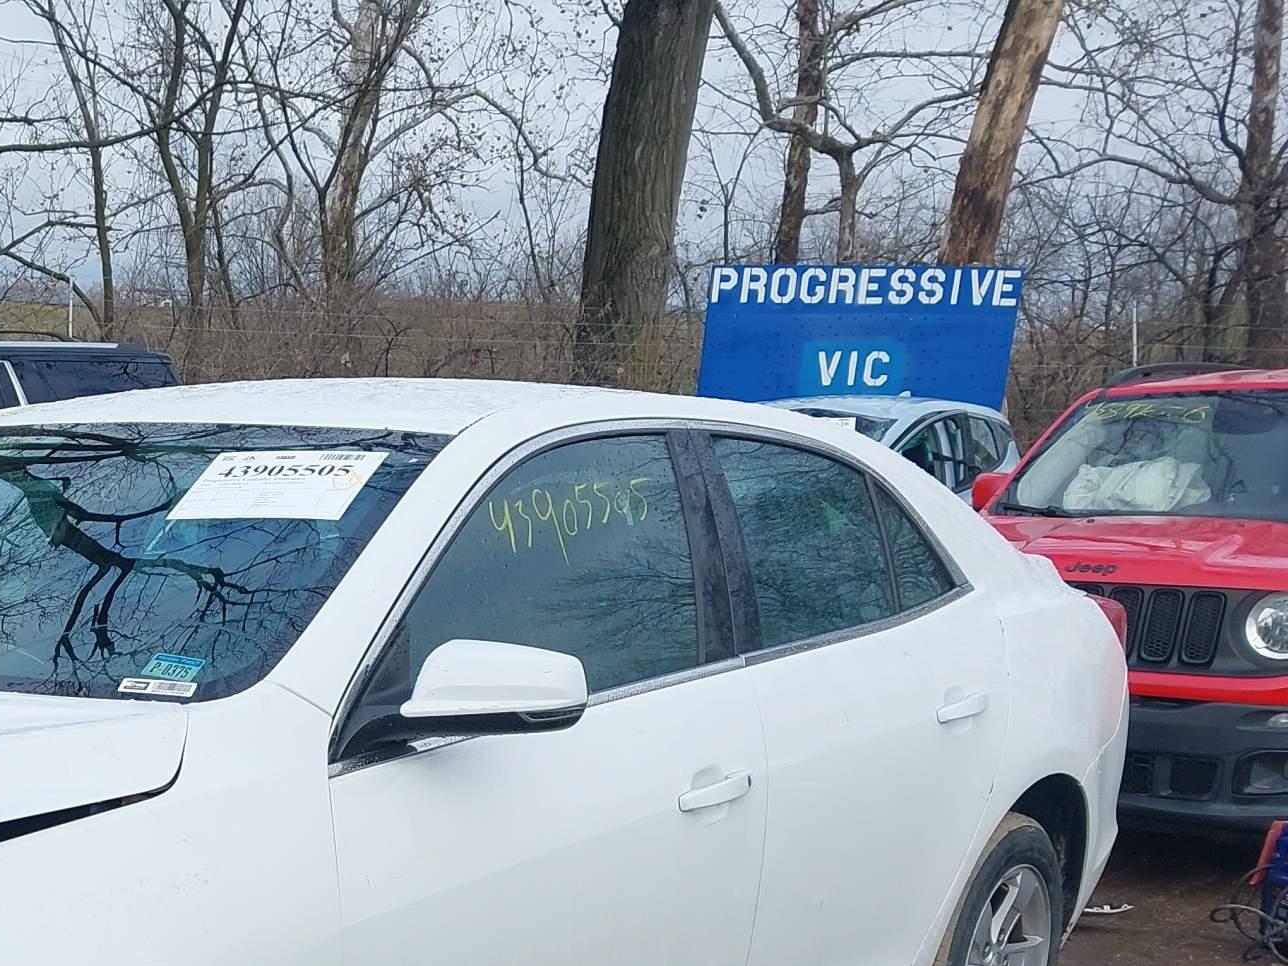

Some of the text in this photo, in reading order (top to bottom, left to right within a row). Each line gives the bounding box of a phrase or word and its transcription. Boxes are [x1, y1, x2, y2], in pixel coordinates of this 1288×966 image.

[711, 267, 1022, 306] PROGRESSIVE
[818, 351, 890, 386] VIC
[218, 464, 355, 478] 43905505
[1064, 561, 1118, 576] Jeep
